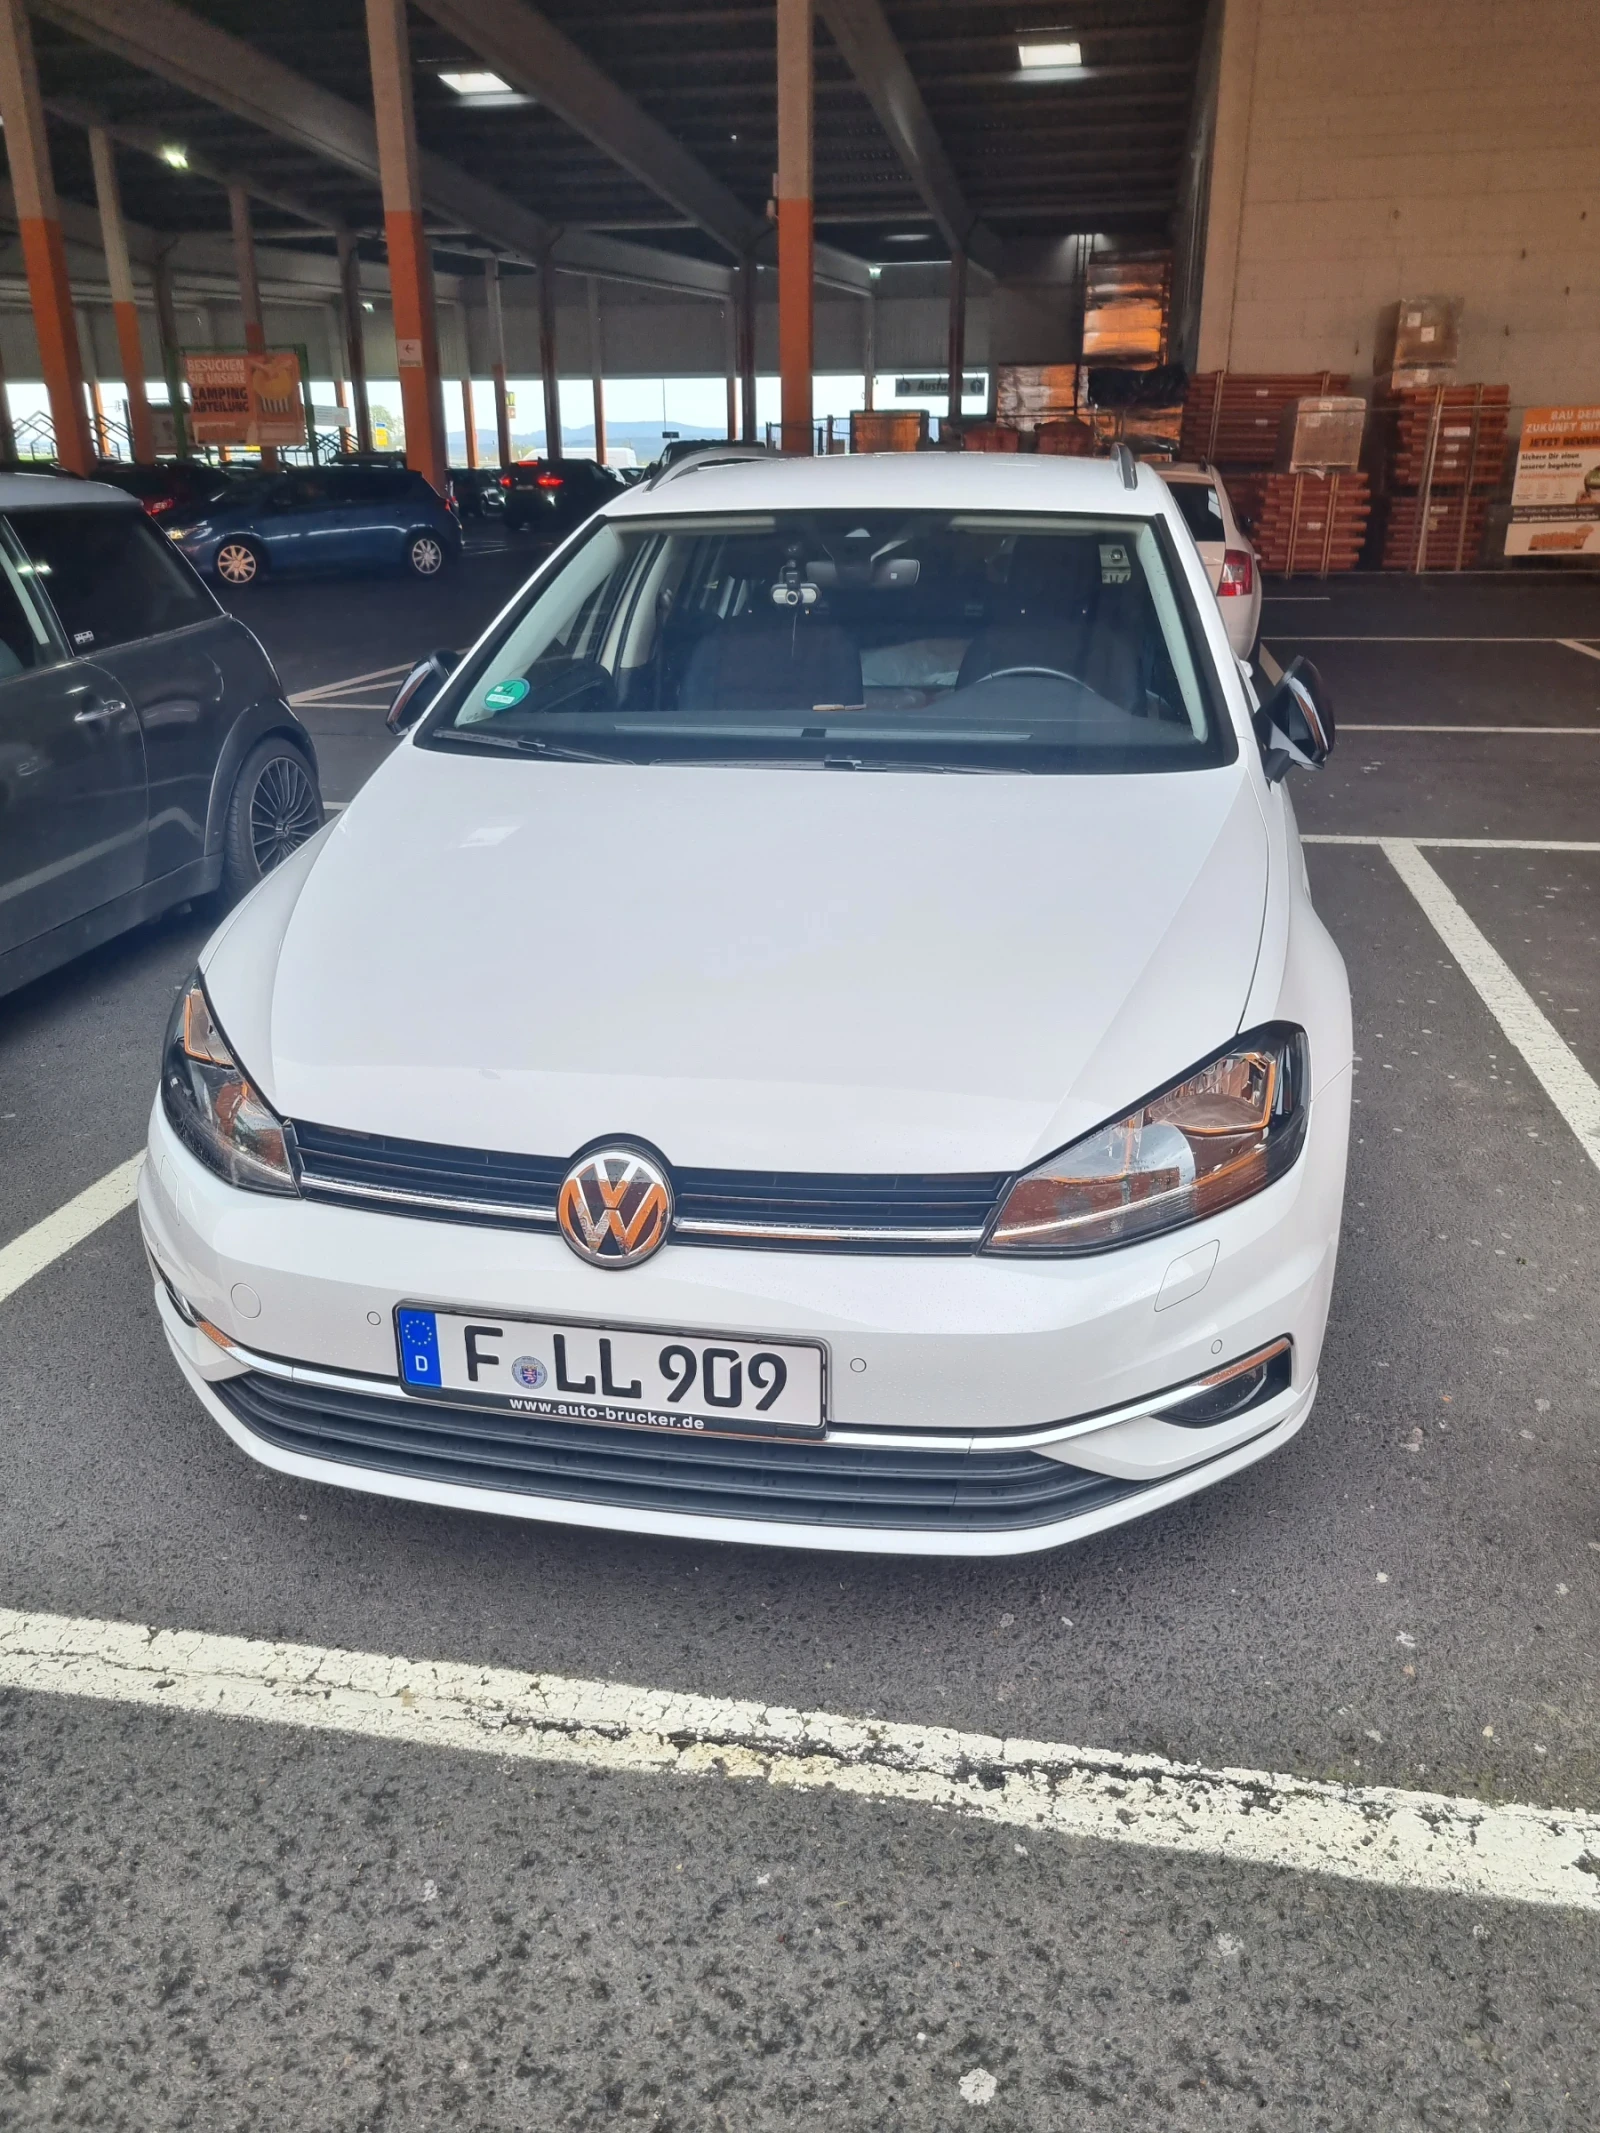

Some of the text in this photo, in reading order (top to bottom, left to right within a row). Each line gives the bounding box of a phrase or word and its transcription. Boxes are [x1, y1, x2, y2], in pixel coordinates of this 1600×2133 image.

[187, 358, 245, 372] BESUCHEN
[189, 372, 247, 385] SIE UNSERE
[917, 380, 949, 392] Ausfa
[191, 387, 249, 401] CAMPING
[193, 401, 250, 414] ABTEILUNG
[1551, 410, 1574, 421] BAU
[1526, 421, 1600, 434] ZUKUNFT MIT
[1530, 437, 1561, 448] JETZT
[415, 1355, 429, 1372] D
[464, 1324, 503, 1382] F
[553, 1333, 642, 1399] LL
[658, 1344, 788, 1411] 909
[509, 1398, 705, 1430] www.auto-brucker.de
